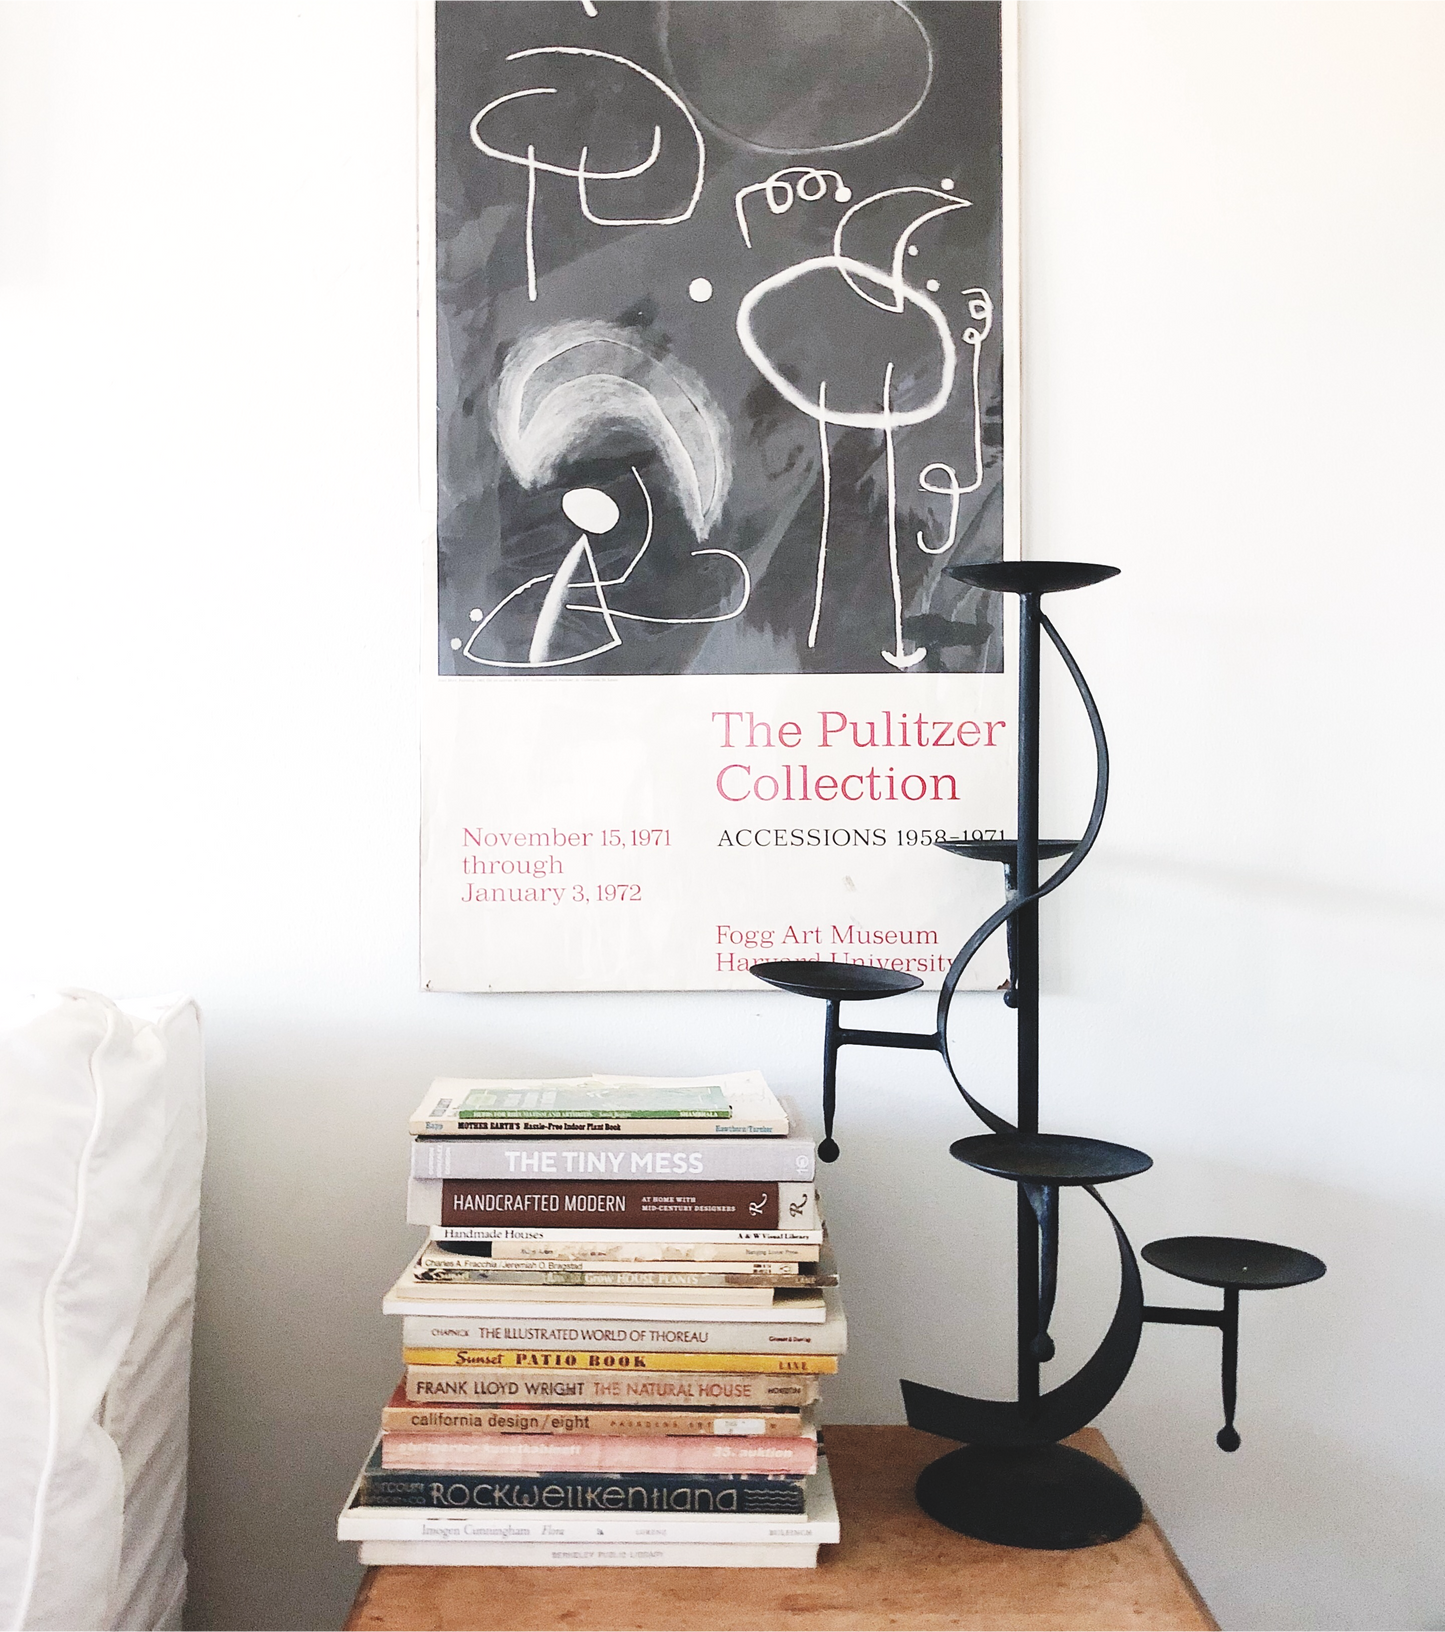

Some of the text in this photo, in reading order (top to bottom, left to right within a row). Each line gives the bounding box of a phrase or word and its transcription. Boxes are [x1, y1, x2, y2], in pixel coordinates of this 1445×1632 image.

[712, 710, 1006, 748] The Pulitzer
[716, 764, 960, 802] Collection
[462, 827, 593, 848] November
[718, 828, 886, 848] ACCESSIONS
[462, 854, 563, 875] through
[461, 883, 642, 905] January 3, 1972
[716, 924, 939, 948] Fogg Art Museum
[458, 1122, 488, 1130] MOTHER
[605, 1123, 621, 1131] Book
[505, 1151, 704, 1175] THE TINY MESS
[454, 1194, 626, 1213] HANDCRAFTED MODERN
[444, 1229, 544, 1239] Handmade Houses
[425, 1260, 454, 1268] Charles
[617, 1274, 654, 1284] HOUSE
[658, 1275, 698, 1284] PLANTS
[479, 1327, 500, 1339] THE
[504, 1327, 578, 1341] ILLUSTRATED
[581, 1329, 626, 1341] WORLD
[630, 1330, 646, 1341] OF
[648, 1330, 708, 1343] THOREAU
[455, 1351, 505, 1365] Sunset
[516, 1353, 577, 1366] PATIO
[589, 1355, 646, 1368] BOOK
[416, 1381, 468, 1395] FRANK
[474, 1381, 519, 1395] LLOYD
[524, 1382, 585, 1396] WRIGHT
[594, 1382, 620, 1396] THE
[626, 1382, 694, 1397] NATURAL
[699, 1384, 751, 1397] HOUSE
[411, 1412, 482, 1427] california
[422, 1524, 460, 1538] Imogen
[463, 1524, 530, 1539] Cunningham
